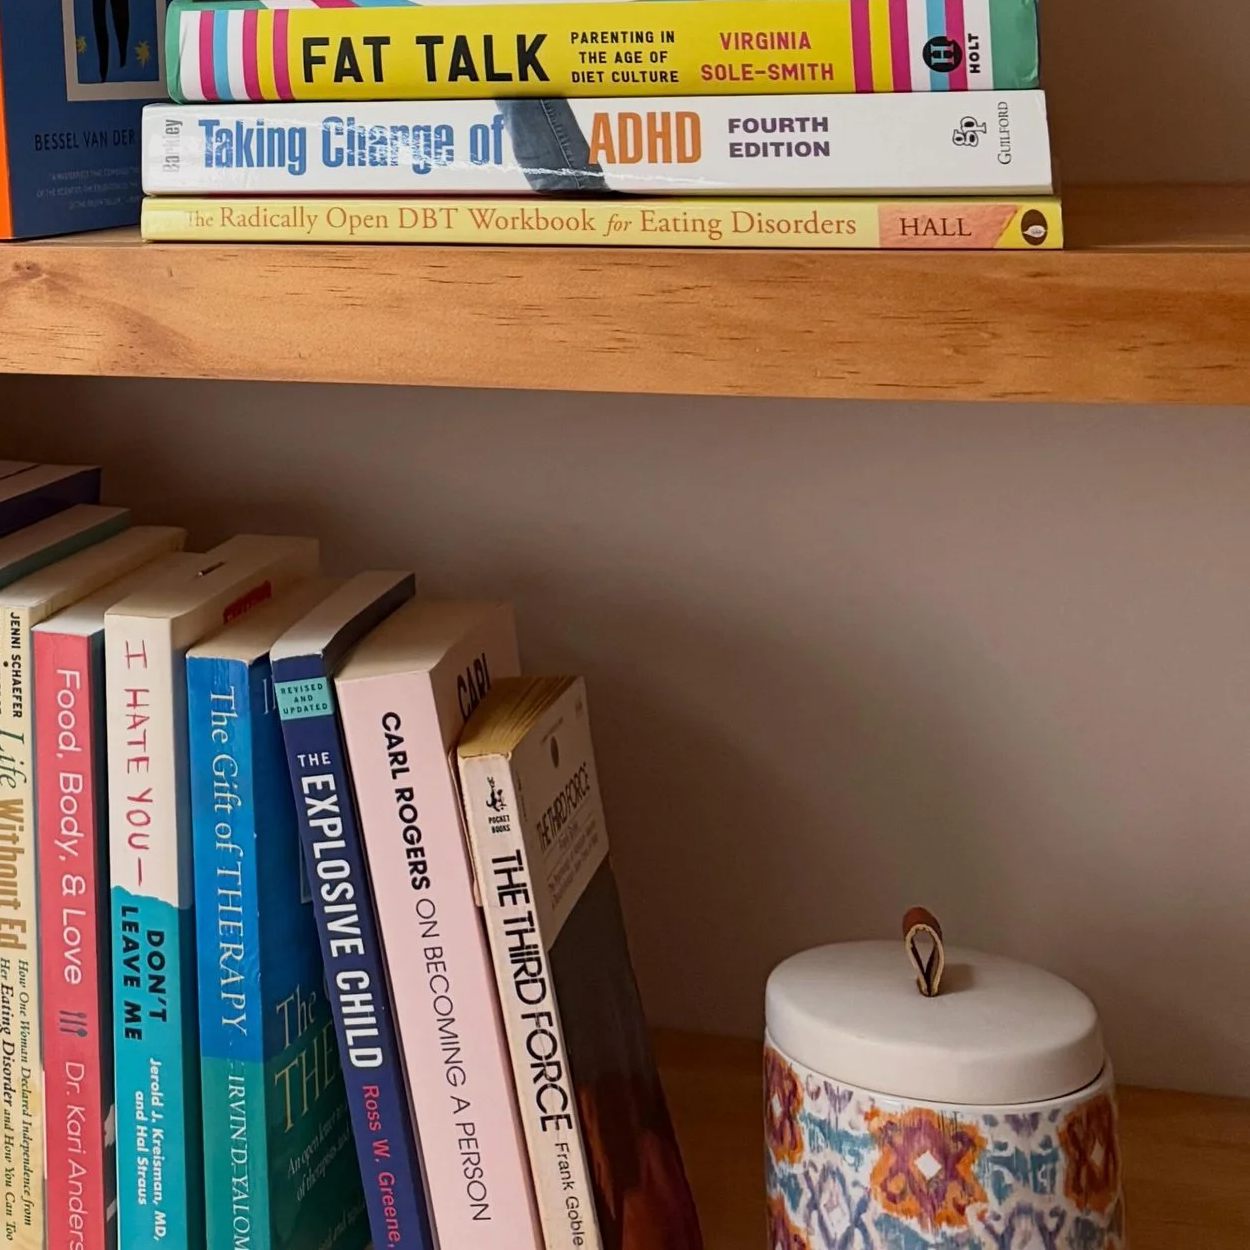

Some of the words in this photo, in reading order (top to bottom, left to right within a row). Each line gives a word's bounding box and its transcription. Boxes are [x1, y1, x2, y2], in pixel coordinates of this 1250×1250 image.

[303, 37, 391, 83] FAT
[416, 34, 550, 82] TALK
[571, 31, 654, 44] PARENTING
[661, 30, 675, 42] IN
[580, 51, 607, 64] THE
[614, 50, 644, 64] AGE
[650, 50, 668, 63] OF
[720, 31, 811, 51] VIRGINIA
[969, 33, 981, 74] HOLT
[572, 70, 604, 84] DIET
[611, 69, 679, 83] CULTURE
[701, 62, 834, 81] SOLE-SMITH
[199, 118, 308, 175] Taking
[322, 116, 455, 174] Charge
[470, 114, 505, 166] of
[589, 110, 702, 165] ADHD
[728, 117, 829, 134] FOURTH
[729, 141, 830, 159] EDITION
[997, 102, 1011, 165] GUILFORD
[186, 209, 214, 227] The
[220, 206, 318, 234] Radically
[327, 207, 388, 234] Open
[398, 207, 459, 229] DBT
[467, 206, 595, 233] Workbook
[603, 213, 632, 237] for
[641, 210, 722, 239] Eating
[731, 209, 856, 235] Disorders
[899, 217, 972, 238] HALL
[10, 612, 21, 649] JENNI
[126, 640, 147, 669] I
[12, 654, 22, 718] SCHAEFER
[281, 684, 323, 694] REVISED
[283, 703, 327, 714] UPDATED
[56, 669, 81, 759] Food,
[124, 688, 150, 774] HATE
[209, 686, 236, 743] The
[297, 752, 331, 767] THE
[381, 712, 409, 780] CARL
[212, 754, 241, 812] Gift
[54, 772, 84, 861] Body,
[127, 788, 152, 887] YOU—
[215, 823, 243, 854] of
[394, 787, 430, 891] ROGERS
[488, 816, 510, 824] POCKET
[491, 825, 510, 834] BOOKS
[62, 874, 86, 896] &
[492, 850, 530, 907] THE
[300, 773, 365, 958] EXPLOSIVE
[336, 970, 384, 1068] CHILD
[416, 898, 440, 938] ON
[62, 908, 84, 985] Love
[121, 905, 142, 987] LEAVE
[217, 861, 247, 1035] THERAPY
[503, 910, 547, 1005] THIRD
[147, 930, 167, 1022] DON'T
[124, 1001, 142, 1041] ME
[423, 946, 466, 1087] BECOMING
[521, 1012, 572, 1132] FORCE
[450, 1096, 470, 1114] A
[455, 1122, 491, 1221] PERSON
[554, 1142, 576, 1190] Frank
[566, 1196, 586, 1246] Goble
